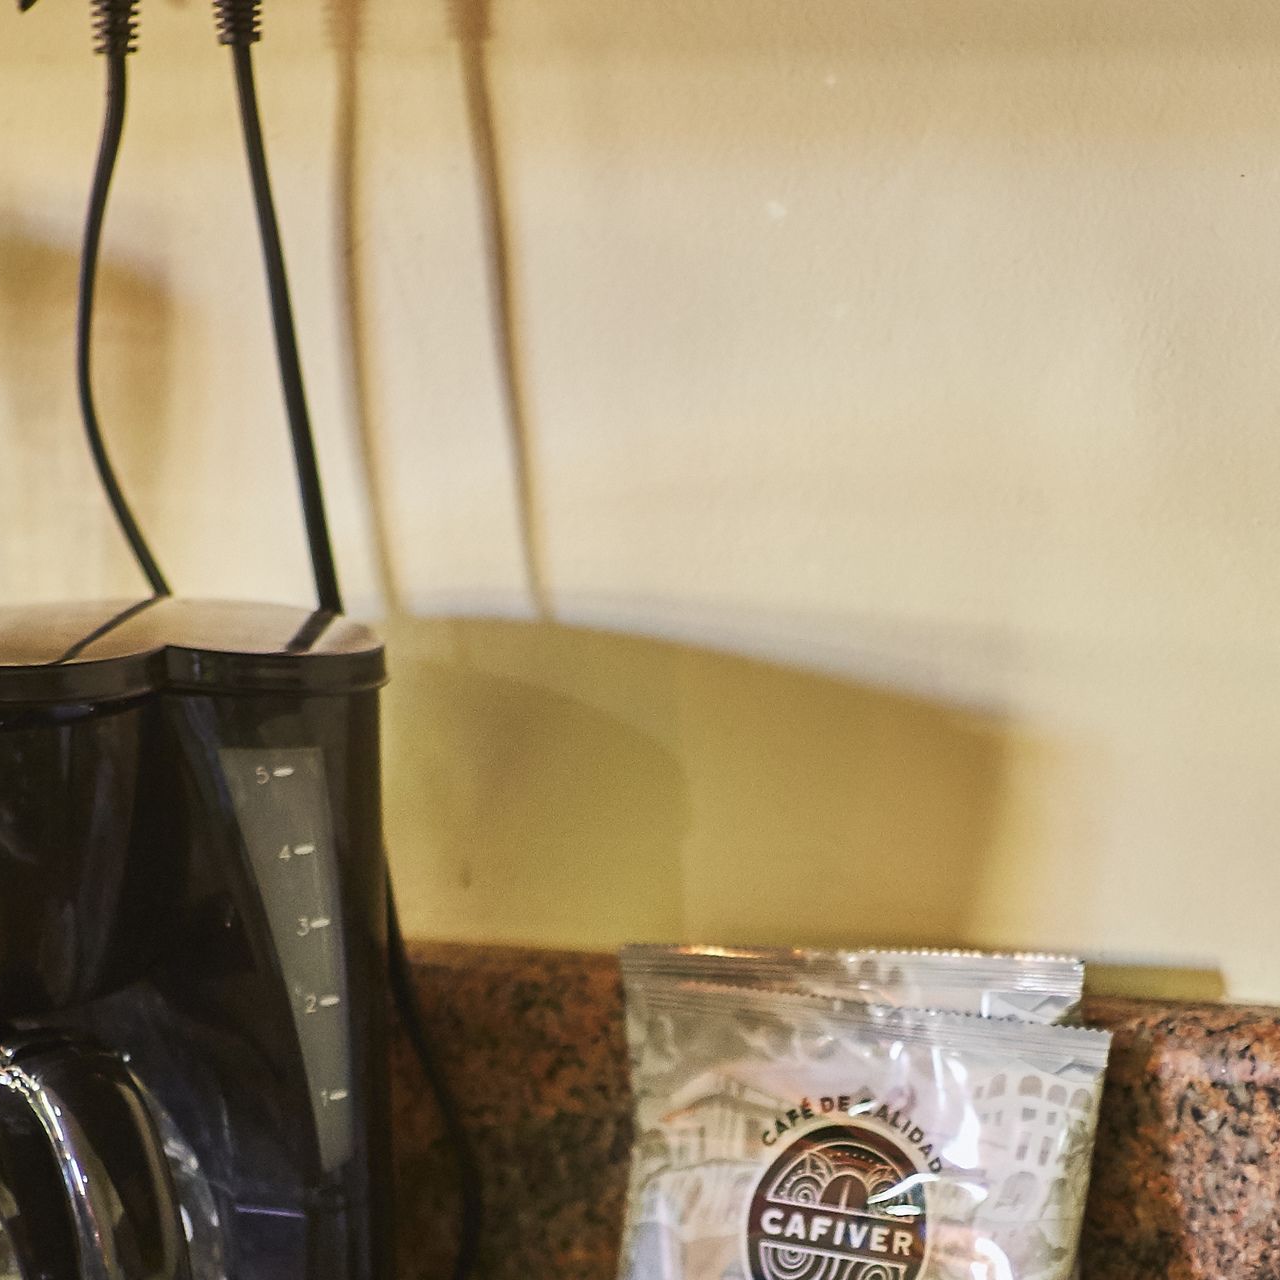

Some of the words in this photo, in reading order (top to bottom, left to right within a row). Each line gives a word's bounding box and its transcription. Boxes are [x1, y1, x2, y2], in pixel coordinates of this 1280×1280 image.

[255, 765, 269, 785] 5
[277, 844, 292, 862] 4
[296, 917, 310, 937] 3
[305, 993, 317, 1013] 2
[762, 1096, 814, 1147] CAFÉ
[820, 1095, 851, 1114] DE
[760, 1207, 913, 1256] CAFIVER
